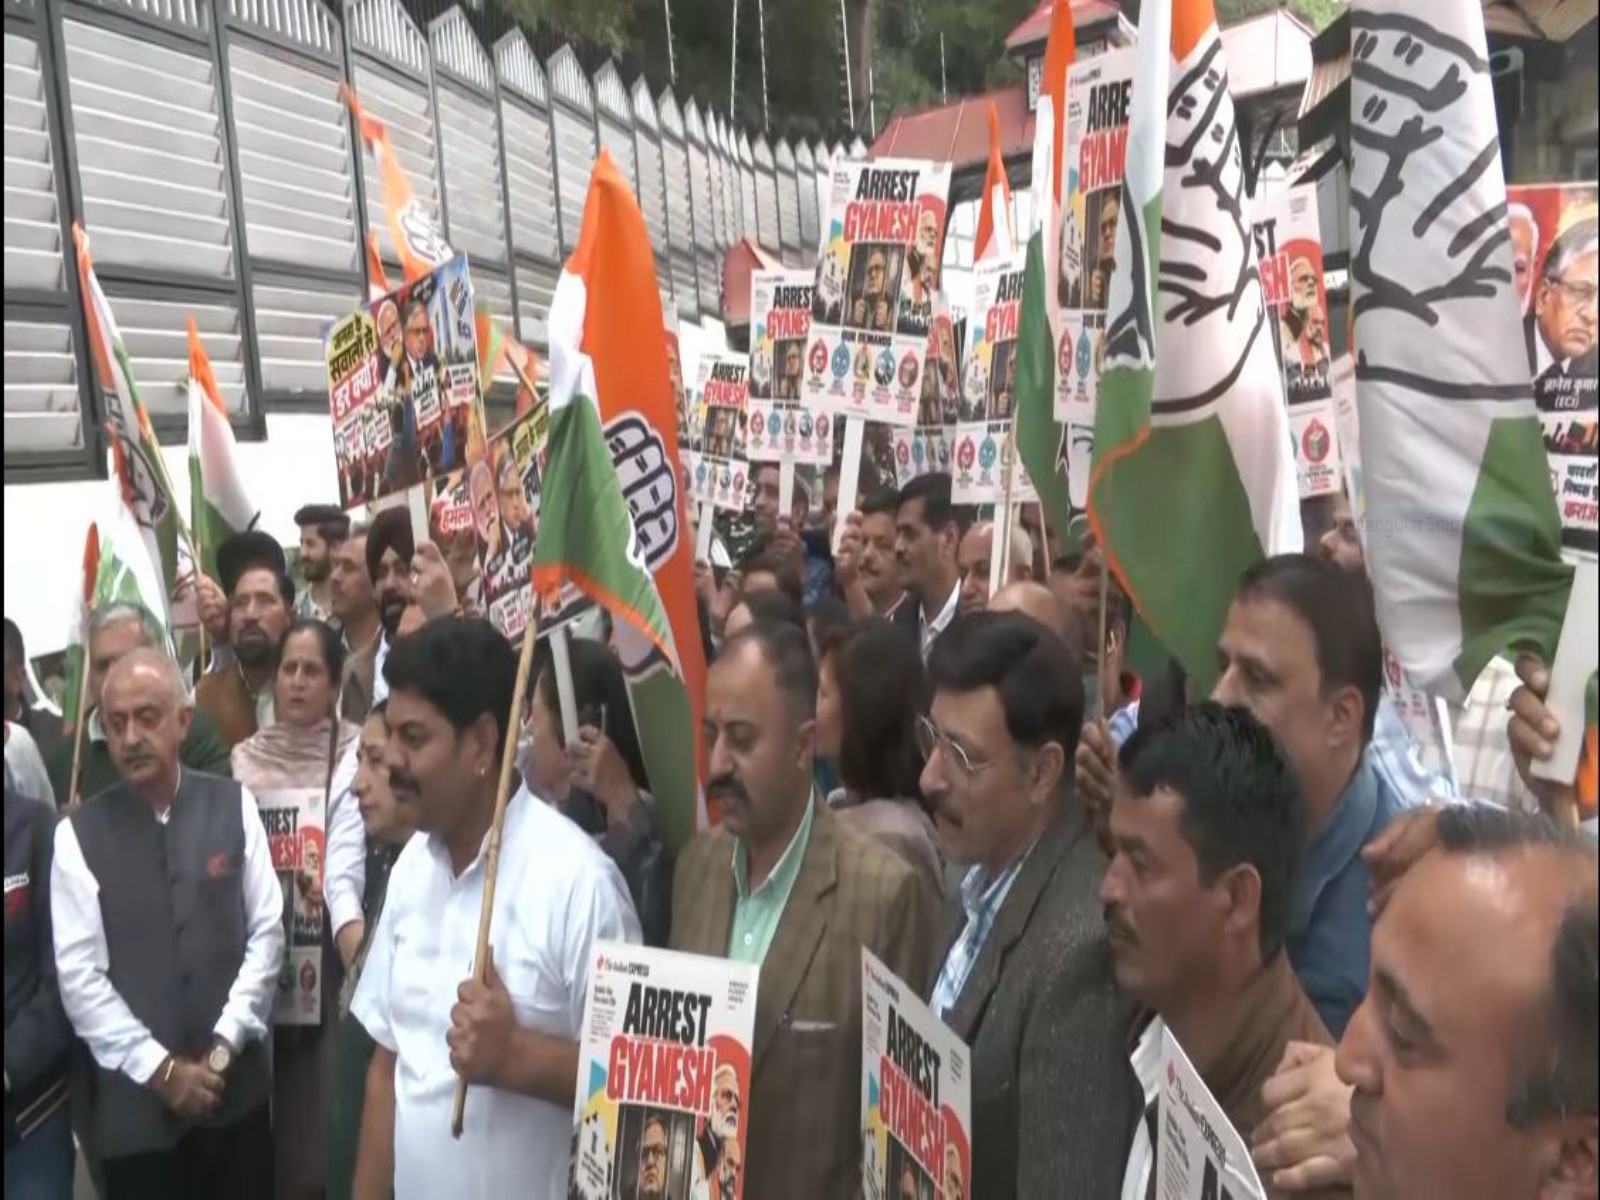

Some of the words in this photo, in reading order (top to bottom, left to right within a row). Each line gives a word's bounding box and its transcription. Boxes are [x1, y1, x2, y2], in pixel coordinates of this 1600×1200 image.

[1087, 79, 1132, 133] ARRE
[1079, 126, 1128, 193] GYAN
[856, 168, 920, 200] ARREST
[843, 202, 921, 242] GYANESH
[995, 272, 1025, 303] ARR
[767, 309, 811, 339] GYANES
[711, 362, 746, 383] ARREST
[258, 807, 300, 835] RREST
[623, 981, 712, 1047] ARREST
[607, 1035, 715, 1113] GYANESH
[887, 1003, 941, 1110] ARREST
[880, 1055, 946, 1191] GYANESH
